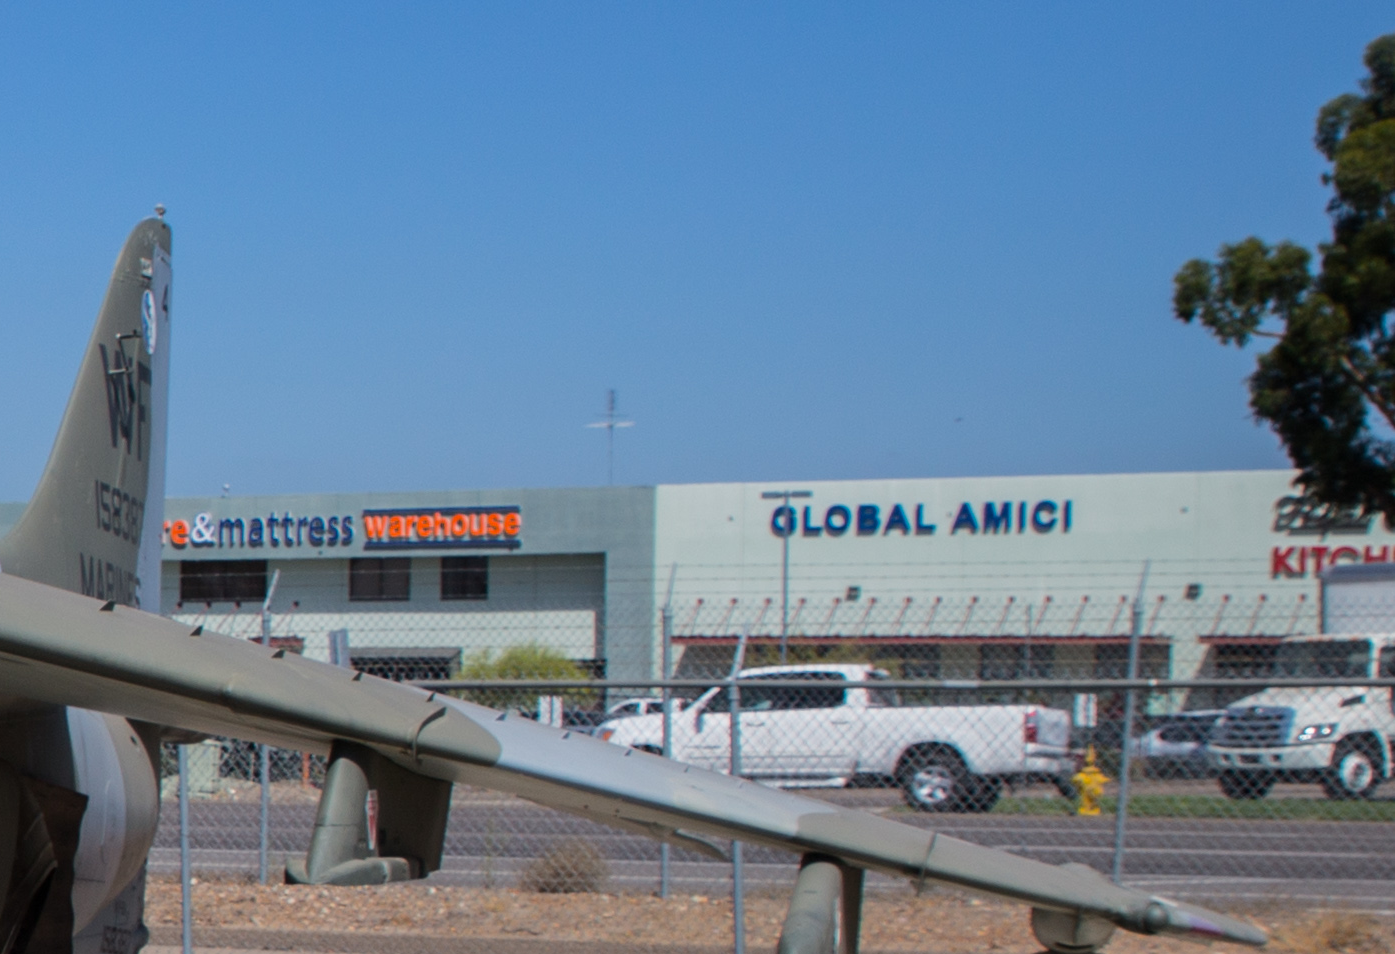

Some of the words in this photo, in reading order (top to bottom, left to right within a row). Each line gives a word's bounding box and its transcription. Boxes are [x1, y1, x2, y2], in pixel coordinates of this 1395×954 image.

[364, 511, 522, 539] warehouse
[769, 502, 937, 538] GLOBAL
[949, 498, 1074, 537] AMICI
[1271, 545, 1395, 578] KITCH
